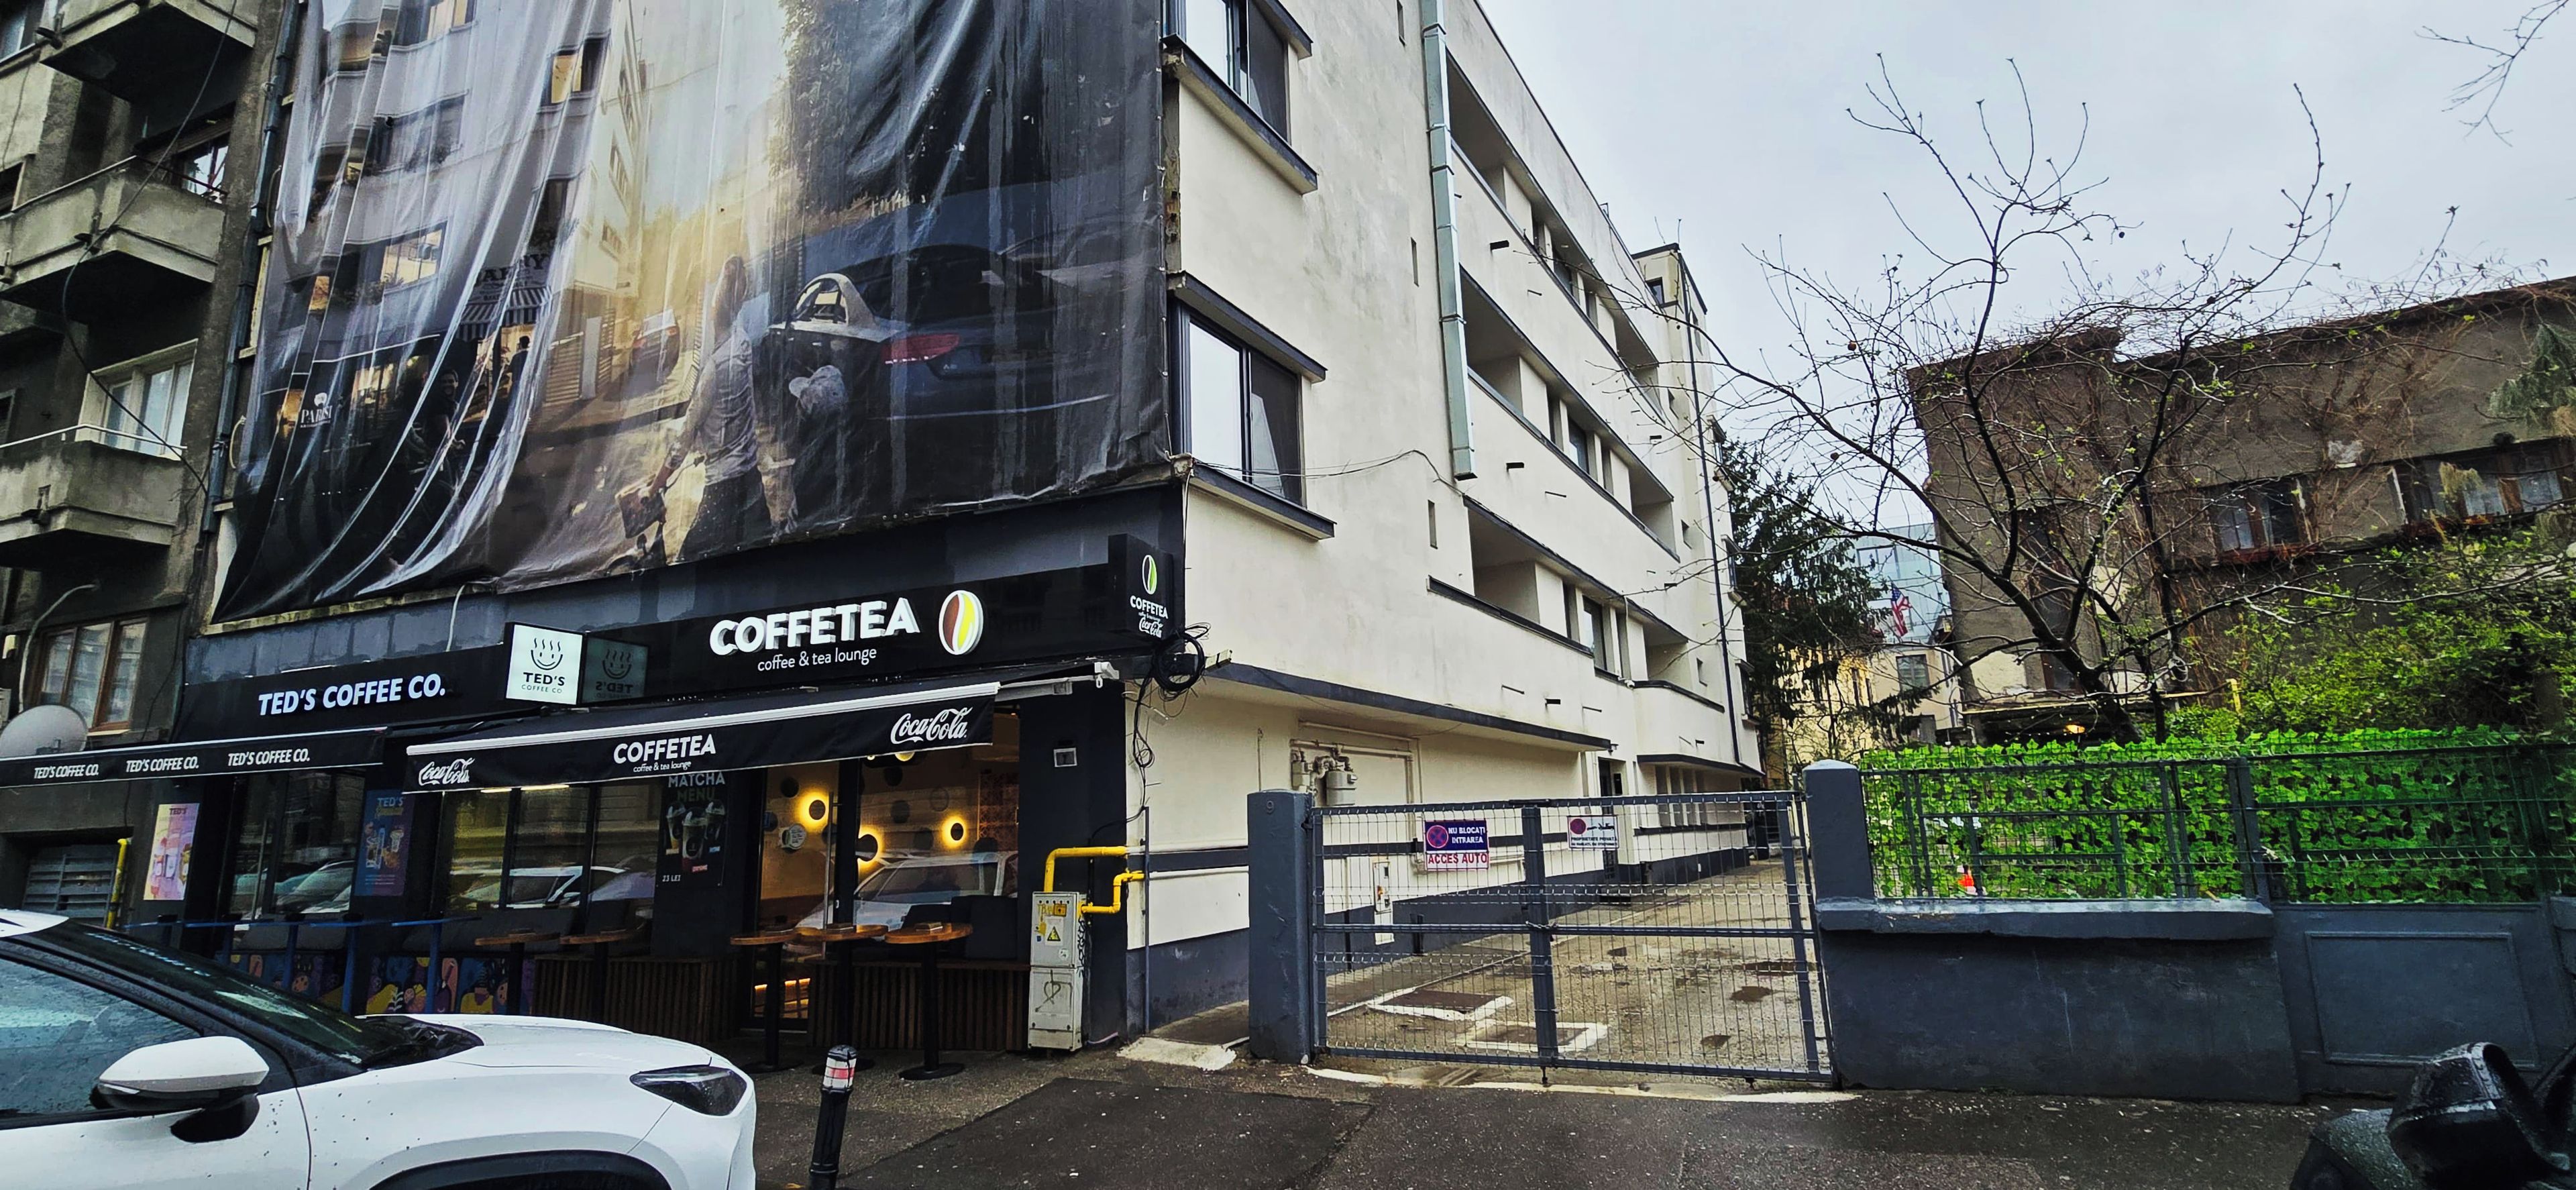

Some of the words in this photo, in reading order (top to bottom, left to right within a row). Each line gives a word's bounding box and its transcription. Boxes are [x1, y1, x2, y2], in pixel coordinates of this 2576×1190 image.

[1130, 595, 1169, 618] COFFETEA
[709, 597, 920, 655] COFFETEA
[757, 654, 795, 671] coffee
[799, 651, 810, 667] &
[812, 653, 831, 665] tea
[835, 647, 877, 665] lounge
[523, 672, 565, 686] TED'S
[258, 688, 317, 716] TED'S
[323, 678, 402, 708] COFFEE
[408, 673, 445, 699] CO.
[521, 684, 549, 692] COFFEE
[890, 707, 973, 744] Coca-Cola
[614, 734, 716, 764] COFFETEA
[125, 759, 150, 772] TED'S
[150, 757, 182, 771] COFFEE
[183, 756, 199, 769] CO.
[227, 752, 255, 766] TED'S
[256, 749, 292, 765] COFFEE
[293, 749, 311, 762] CO.
[34, 766, 55, 779] TED'S
[56, 765, 85, 777] COFFEE
[85, 764, 99, 775] CO.
[419, 757, 475, 786] Coca-Cola
[633, 763, 653, 773] coffee
[653, 762, 659, 771] &
[671, 761, 692, 770] lounge
[668, 772, 725, 788] MATCHA
[678, 788, 715, 802] MENU
[1266, 800, 1274, 814] 9
[1428, 854, 1458, 863] ACCES
[1462, 854, 1487, 863] AUTO
